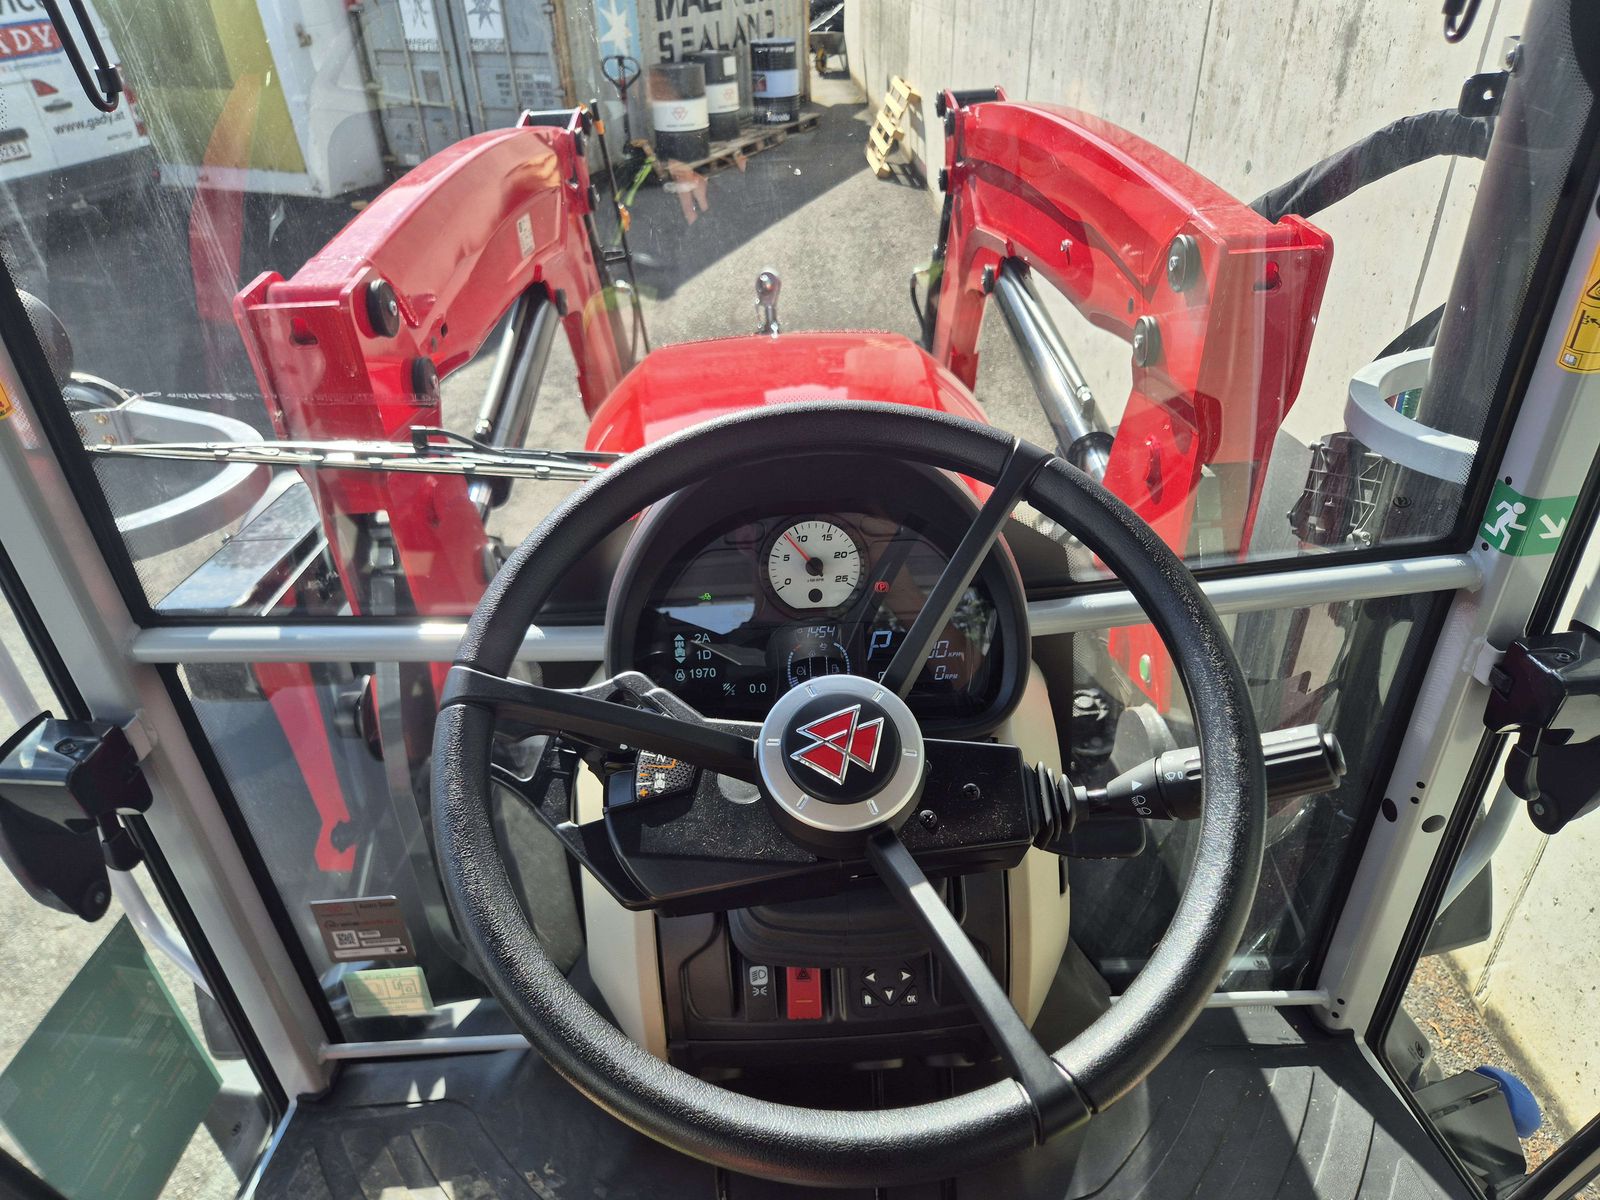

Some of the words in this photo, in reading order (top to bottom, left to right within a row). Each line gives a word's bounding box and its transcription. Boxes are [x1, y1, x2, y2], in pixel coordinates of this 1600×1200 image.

[796, 535, 808, 543] 10
[783, 554, 790, 562] 5
[834, 551, 848, 559] 20
[835, 575, 849, 583] 25
[694, 633, 711, 643] 2A
[867, 630, 893, 662] P
[696, 650, 712, 660] 1D
[689, 667, 717, 678] 1970
[934, 665, 946, 680] 0
[749, 683, 767, 694] 0.0
[906, 995, 917, 1004] OK
